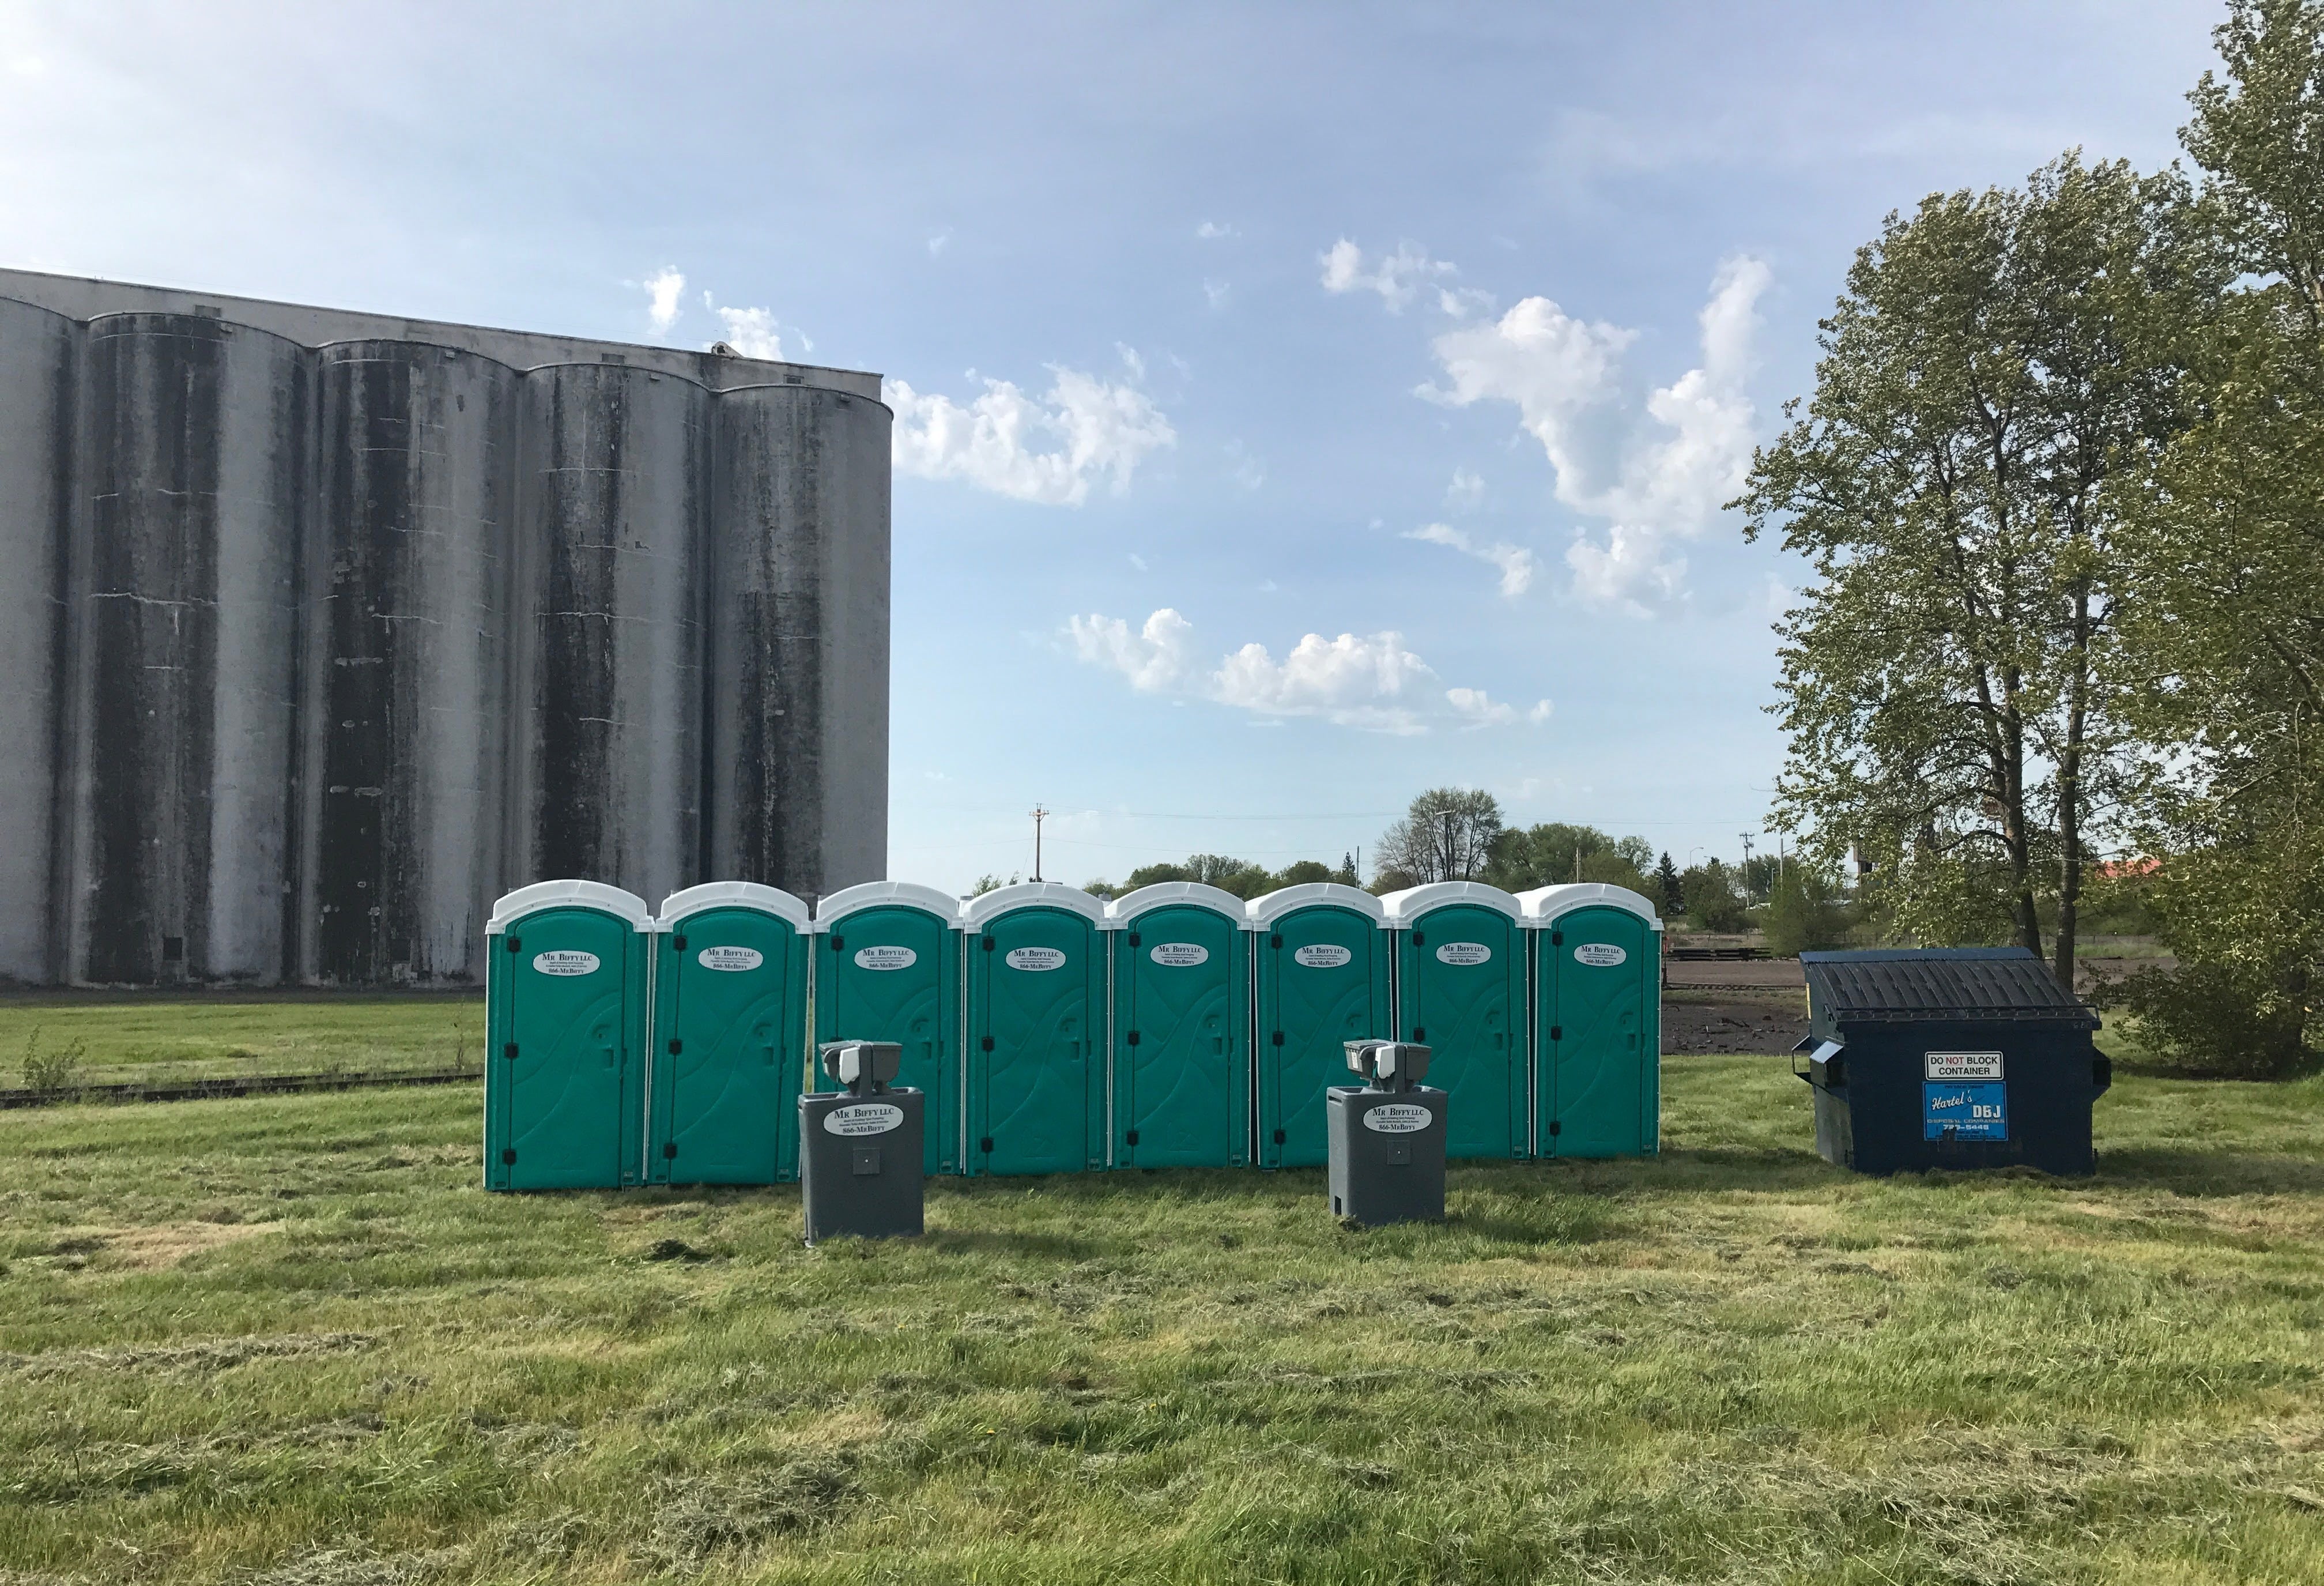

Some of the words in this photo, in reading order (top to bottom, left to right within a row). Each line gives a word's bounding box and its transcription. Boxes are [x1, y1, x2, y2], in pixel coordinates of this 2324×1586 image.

[1967, 1056, 1998, 1064] BLOCK
[1938, 1067, 1990, 1075] CONTAINER
[1931, 1089, 1972, 1110] Hartel's
